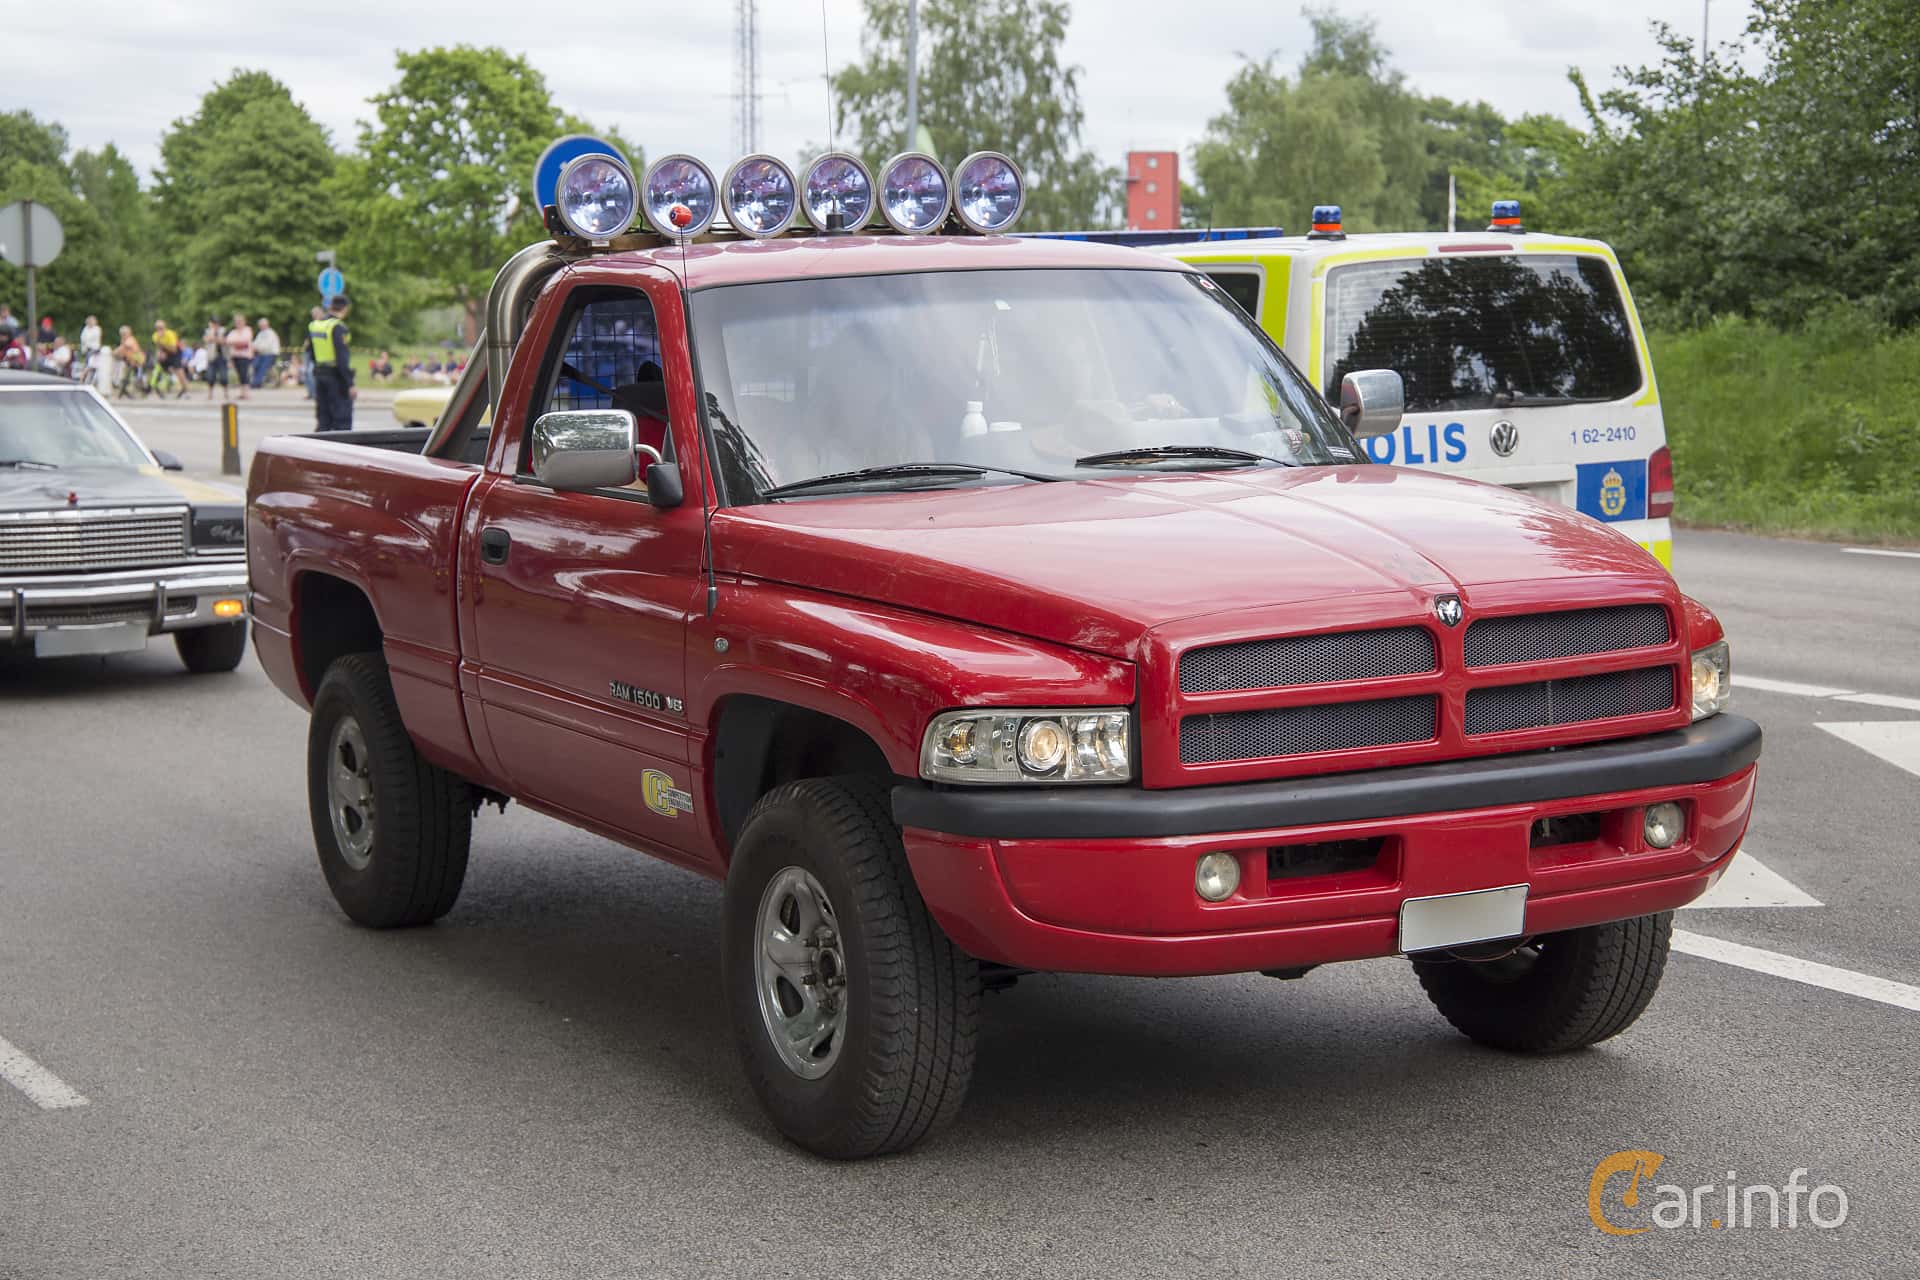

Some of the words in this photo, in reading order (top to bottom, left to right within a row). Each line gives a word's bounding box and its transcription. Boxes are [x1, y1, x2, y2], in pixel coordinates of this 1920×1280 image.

[1356, 422, 1466, 464] OLIS
[1583, 426, 1636, 443] 62-2410
[609, 681, 630, 702] RAM
[633, 689, 660, 710] 1500
